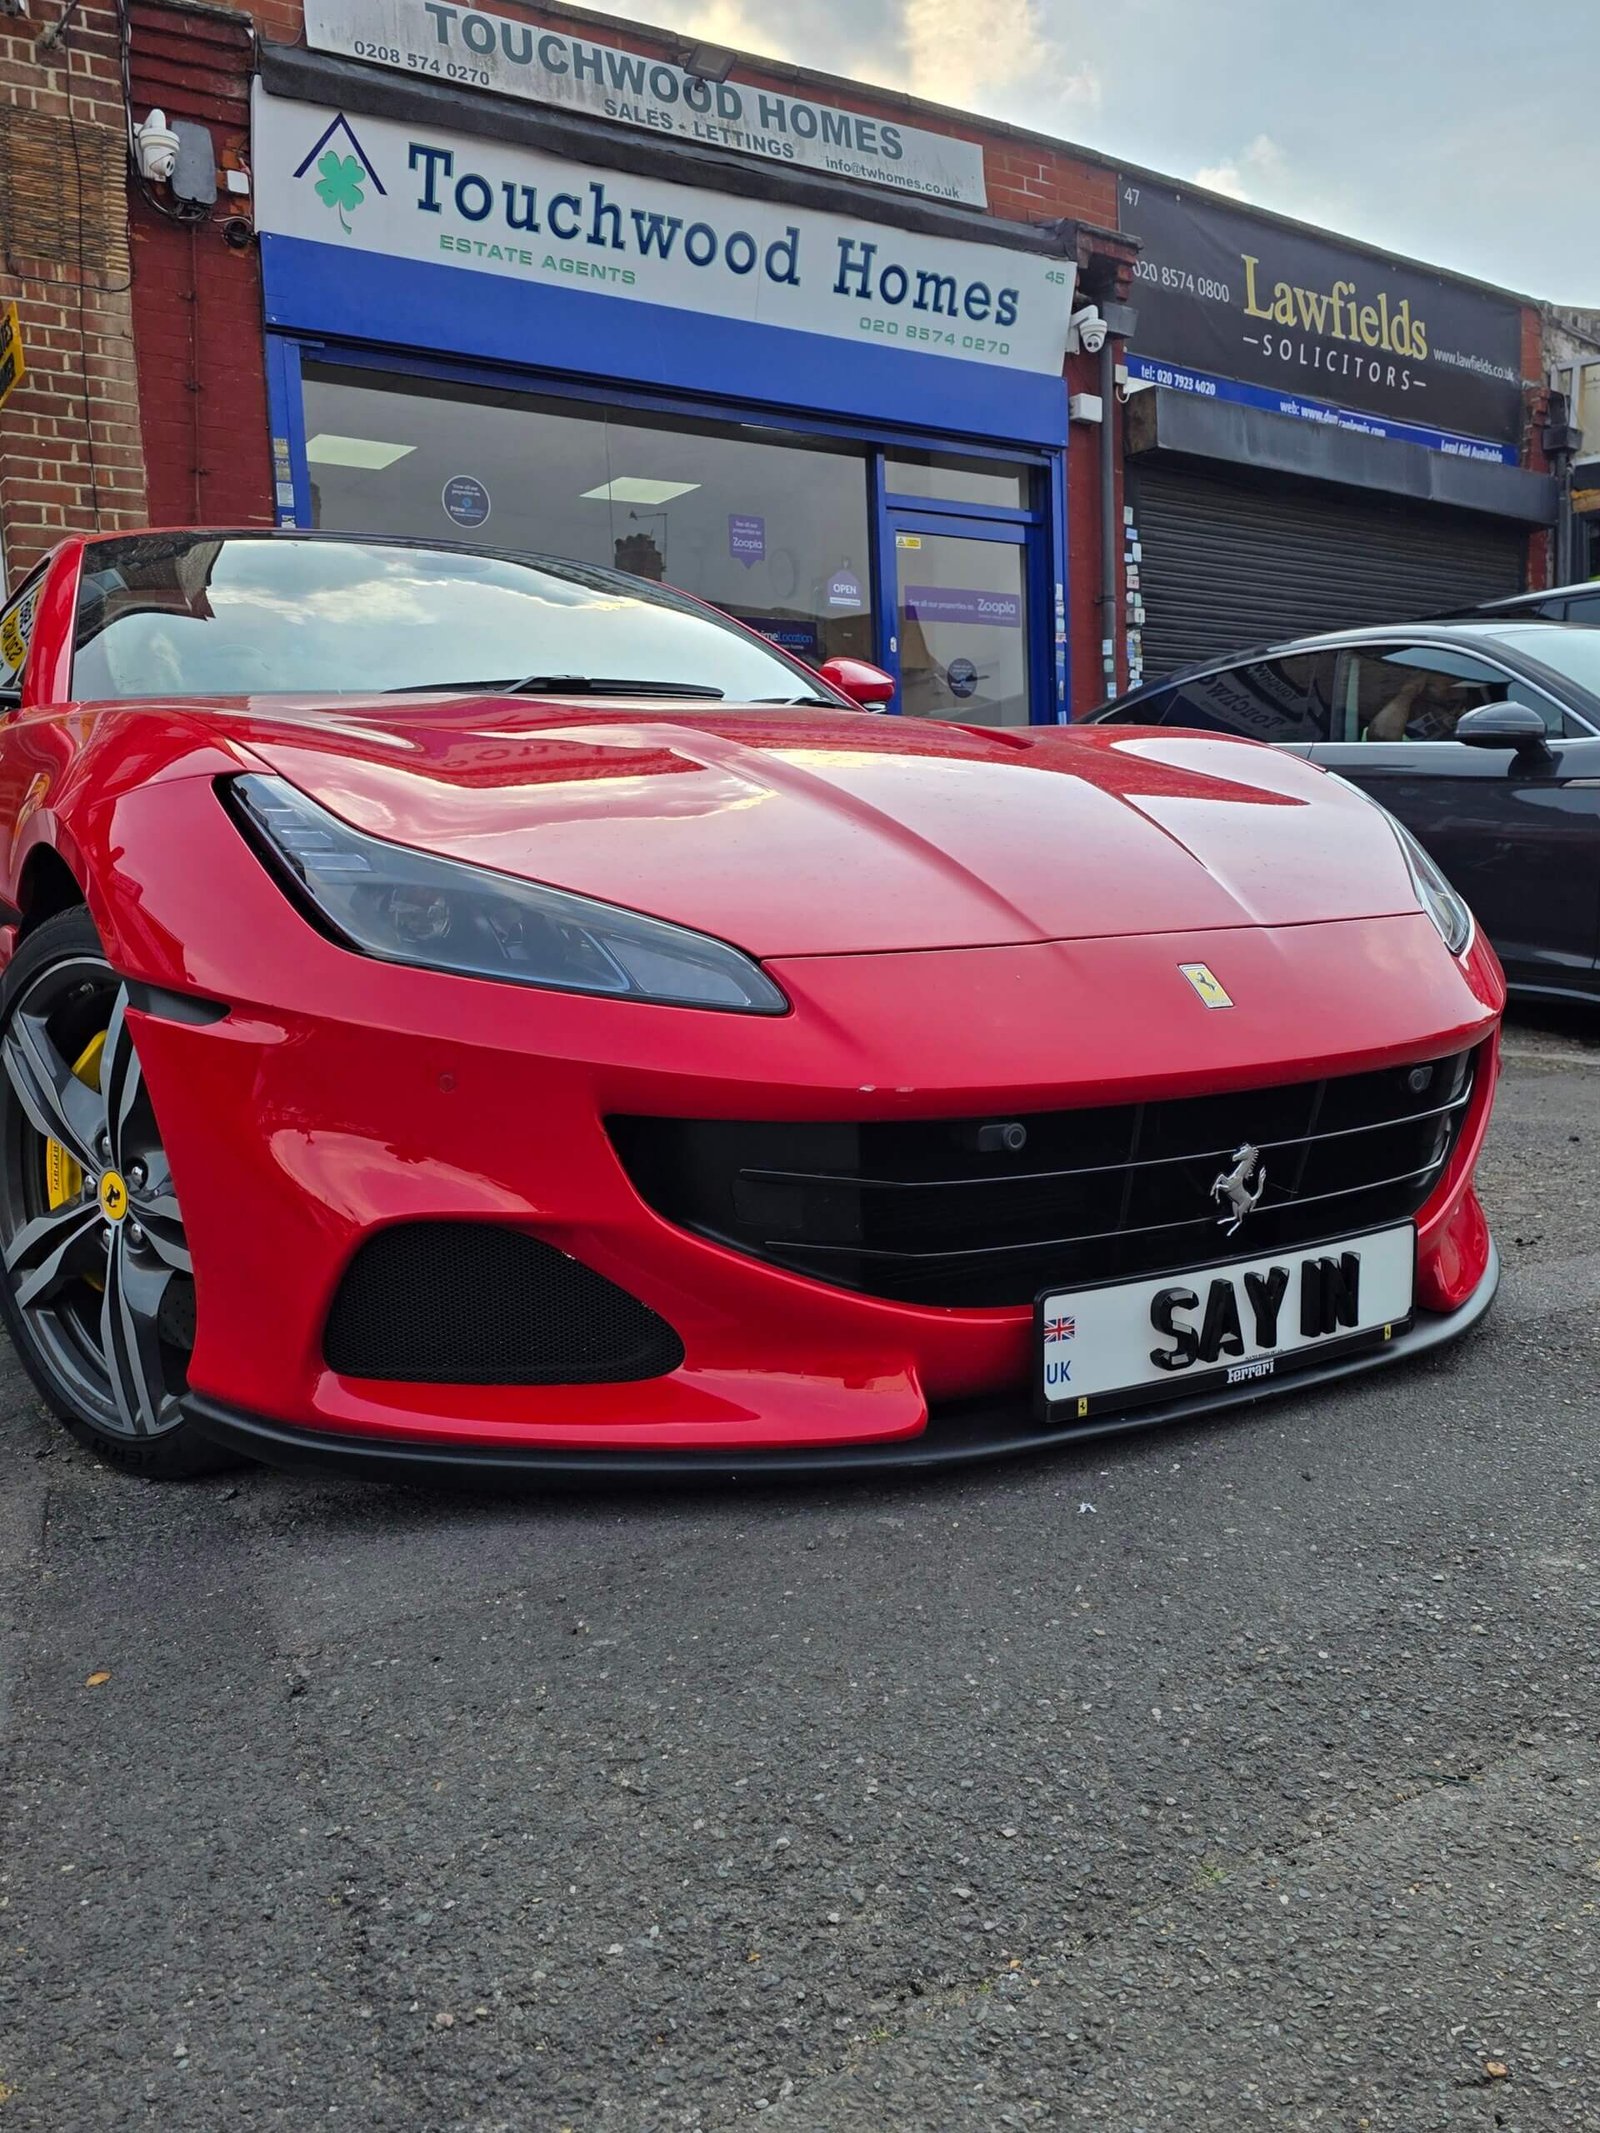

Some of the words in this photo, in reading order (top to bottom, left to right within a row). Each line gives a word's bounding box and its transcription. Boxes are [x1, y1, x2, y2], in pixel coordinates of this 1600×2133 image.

[354, 40, 400, 64] 0208
[407, 53, 440, 74] 574
[447, 63, 490, 86] 0270
[425, 2, 742, 120] TOUCHWOOD
[758, 94, 904, 160] HOMES
[604, 99, 673, 130] SALES
[693, 121, 794, 158] LETTINGS
[826, 157, 960, 199] info@twhomes.co.uk
[1124, 187, 1140, 206] 47
[408, 142, 800, 286] Touchwood
[833, 237, 1020, 327] Homes
[439, 234, 533, 265] ESTATE
[542, 255, 636, 285] AGENTS
[1045, 270, 1065, 285] 45
[1162, 266, 1194, 292] 8574
[1198, 277, 1230, 303] 0800
[1241, 254, 1428, 361] Lawfields
[860, 317, 898, 335] 020
[906, 325, 955, 346] 8574
[963, 336, 1010, 355] 0270
[1141, 364, 1155, 380] tel:
[1157, 369, 1172, 384] 020
[1174, 374, 1193, 390] 7923
[1433, 348, 1515, 381] www.lawfields.co.uk
[1279, 400, 1300, 416] web:
[732, 536, 763, 550] Zoopla
[833, 583, 857, 594] OPEN
[977, 598, 1016, 615] Zoopla
[760, 629, 813, 646] imeLocation
[1046, 1360, 1072, 1384] UK
[1226, 1359, 1275, 1384] Ferrari
